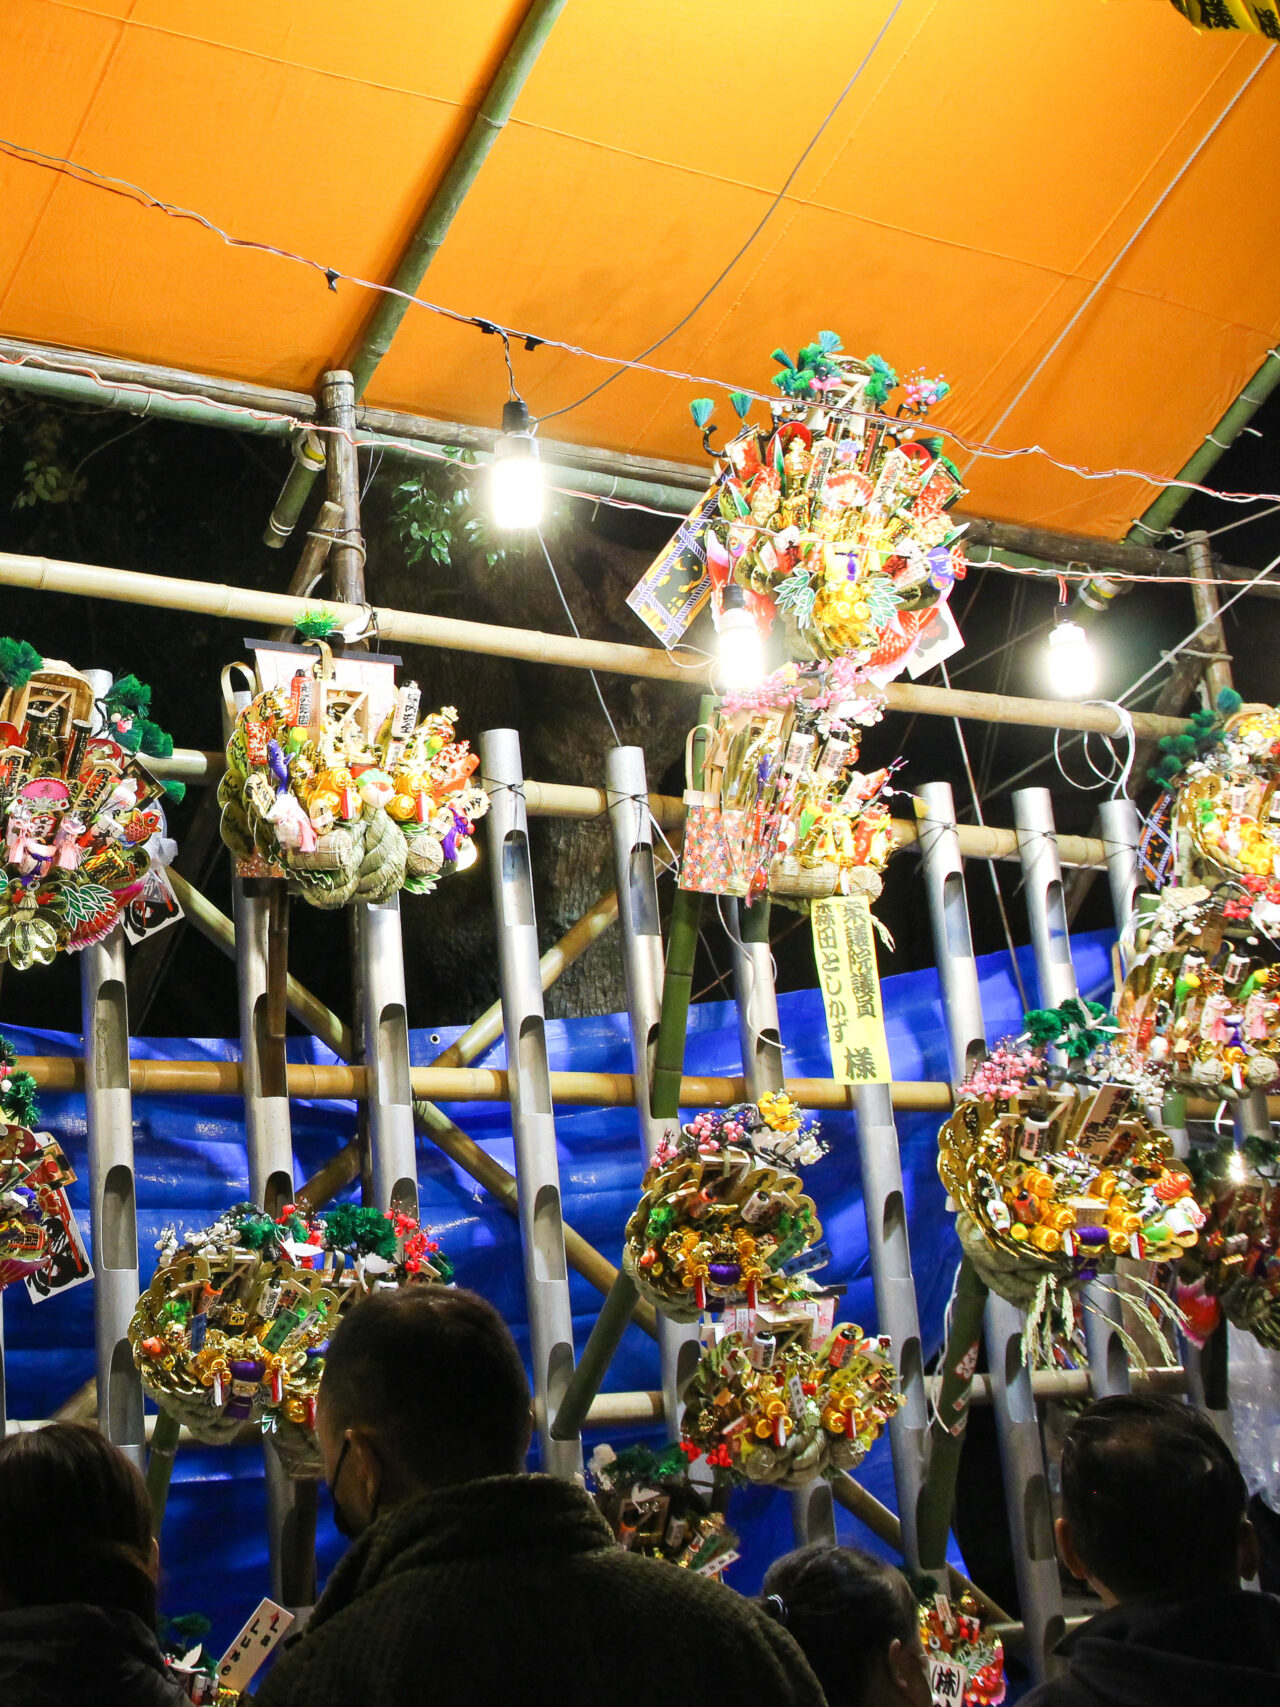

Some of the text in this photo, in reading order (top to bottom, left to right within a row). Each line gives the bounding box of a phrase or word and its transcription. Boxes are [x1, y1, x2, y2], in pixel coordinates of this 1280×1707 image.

[814, 901, 848, 1043] 森田としかず
[845, 1045, 878, 1081] 様
